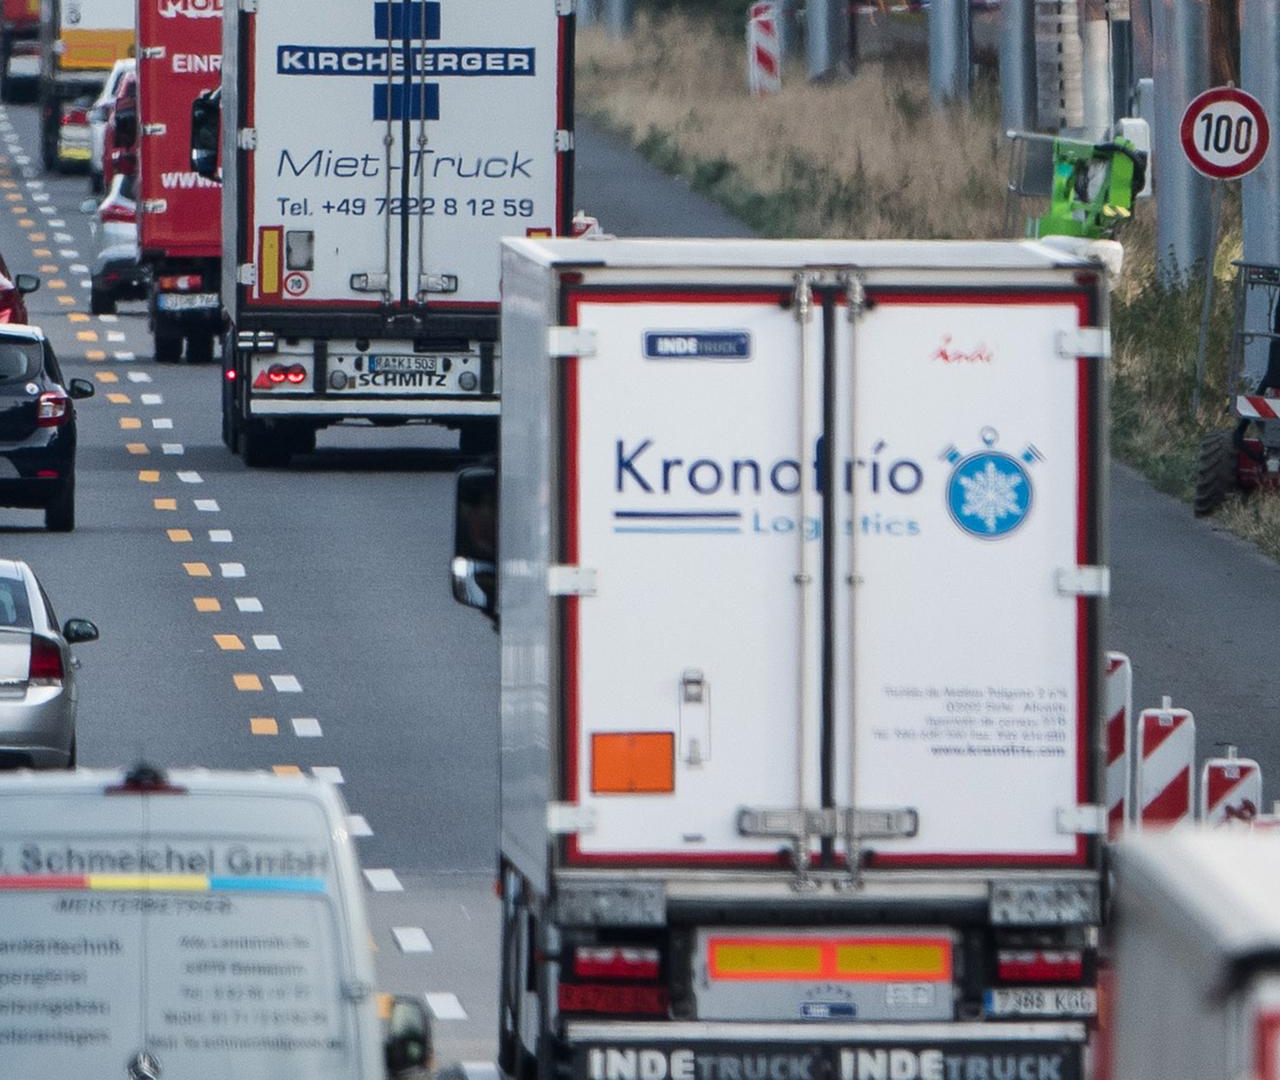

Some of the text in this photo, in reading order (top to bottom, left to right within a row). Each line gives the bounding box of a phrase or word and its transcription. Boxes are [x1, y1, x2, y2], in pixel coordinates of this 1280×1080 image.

[1201, 113, 1252, 155] 100
[277, 197, 313, 217] Tel.
[322, 198, 366, 216] +49
[444, 198, 458, 216] 8
[467, 198, 495, 217] 12
[503, 199, 535, 217] 59
[359, 373, 447, 387] SCHMITZ
[752, 512, 920, 541] Logstics
